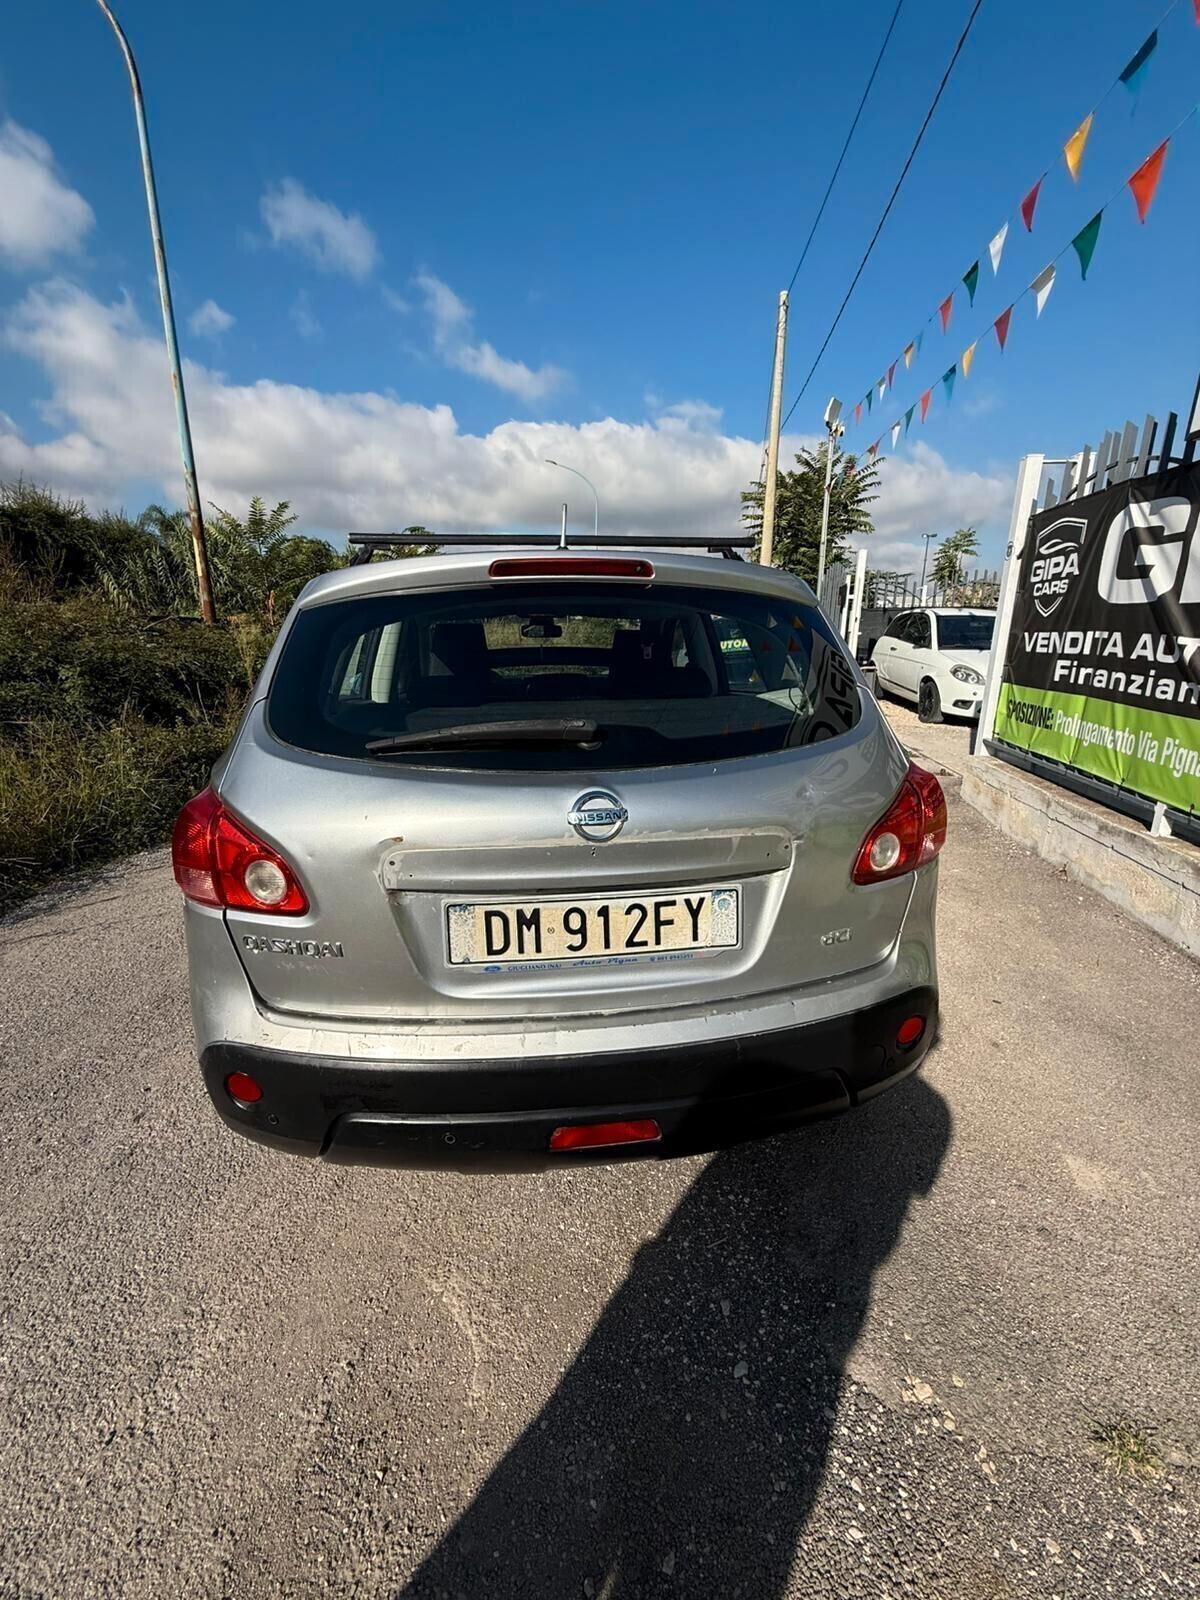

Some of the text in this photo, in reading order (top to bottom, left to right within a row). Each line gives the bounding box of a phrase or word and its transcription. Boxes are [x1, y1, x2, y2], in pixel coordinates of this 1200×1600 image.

[1030, 552, 1079, 583] GIPA
[1033, 579, 1069, 597] CARS
[1024, 631, 1124, 659] VENDITA
[1137, 730, 1159, 763] Via
[576, 811, 622, 823] NISSAN
[484, 897, 706, 956] DM 912FY
[242, 935, 344, 959] QASHQAI
